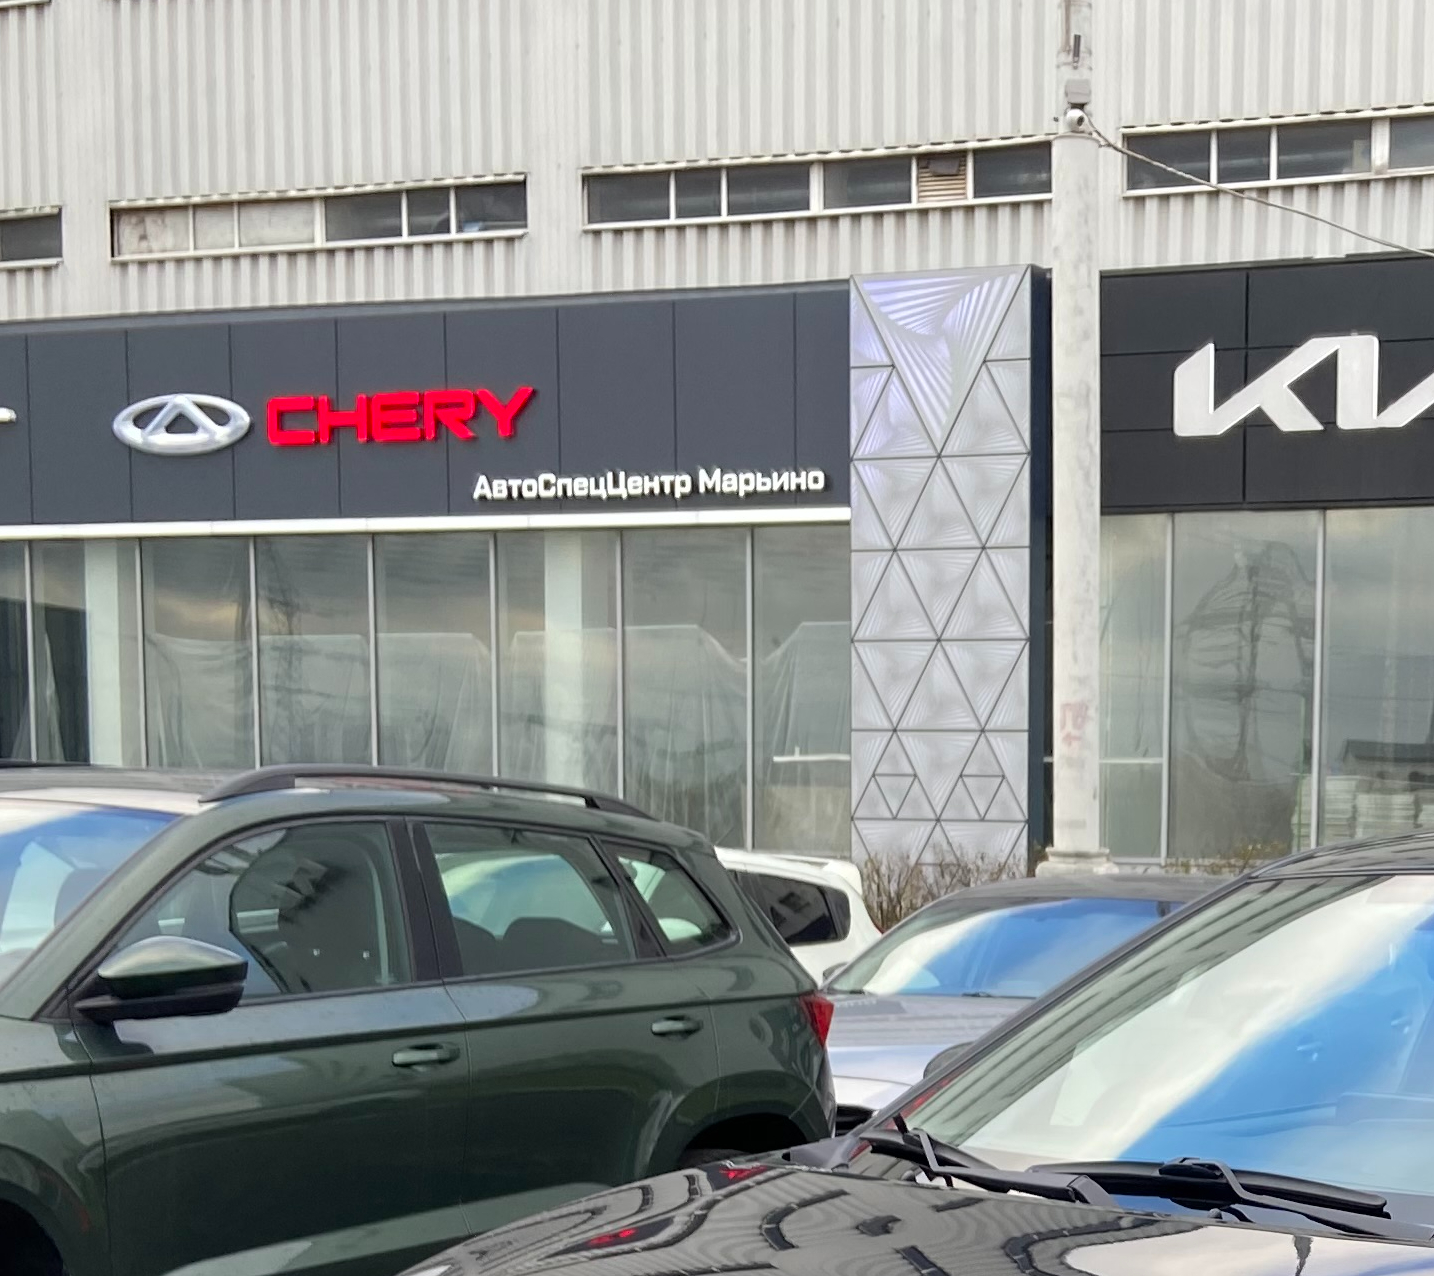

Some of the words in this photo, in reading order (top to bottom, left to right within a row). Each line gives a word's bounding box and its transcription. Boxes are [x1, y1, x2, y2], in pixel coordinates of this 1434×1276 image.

[266, 386, 534, 446] CHERY
[473, 471, 693, 499] АвтоСпецЦентр
[698, 467, 826, 497] Марьино
